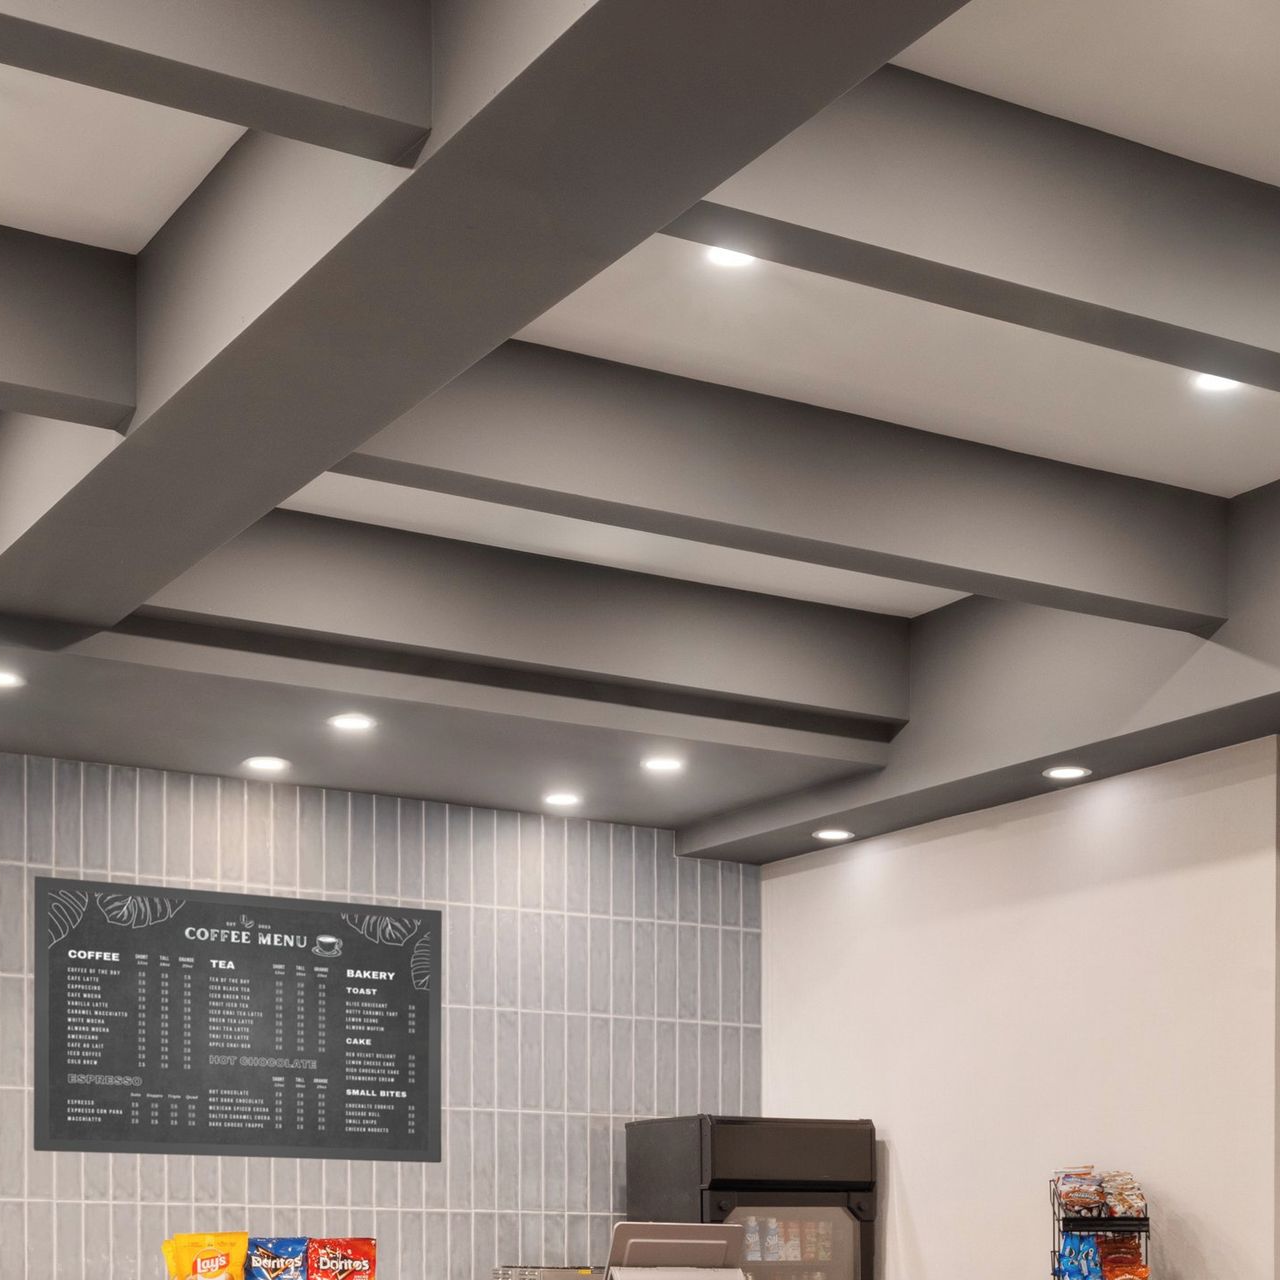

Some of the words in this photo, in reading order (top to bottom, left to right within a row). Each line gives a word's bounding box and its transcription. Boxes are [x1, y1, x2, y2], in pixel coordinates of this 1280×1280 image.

[185, 927, 250, 944] COFFEE
[258, 932, 307, 948] MENU
[68, 950, 120, 962] COFFEE
[210, 960, 235, 970] TEA
[346, 969, 395, 980] BAKERY
[346, 987, 377, 995] TOAST
[209, 1055, 237, 1065] HOT
[240, 1056, 317, 1069] CHOCOLATE
[68, 1074, 142, 1086] ESPRESSO
[197, 1254, 226, 1273] Lay's
[251, 1255, 302, 1268] Doritos
[320, 1257, 370, 1271] Doritos
